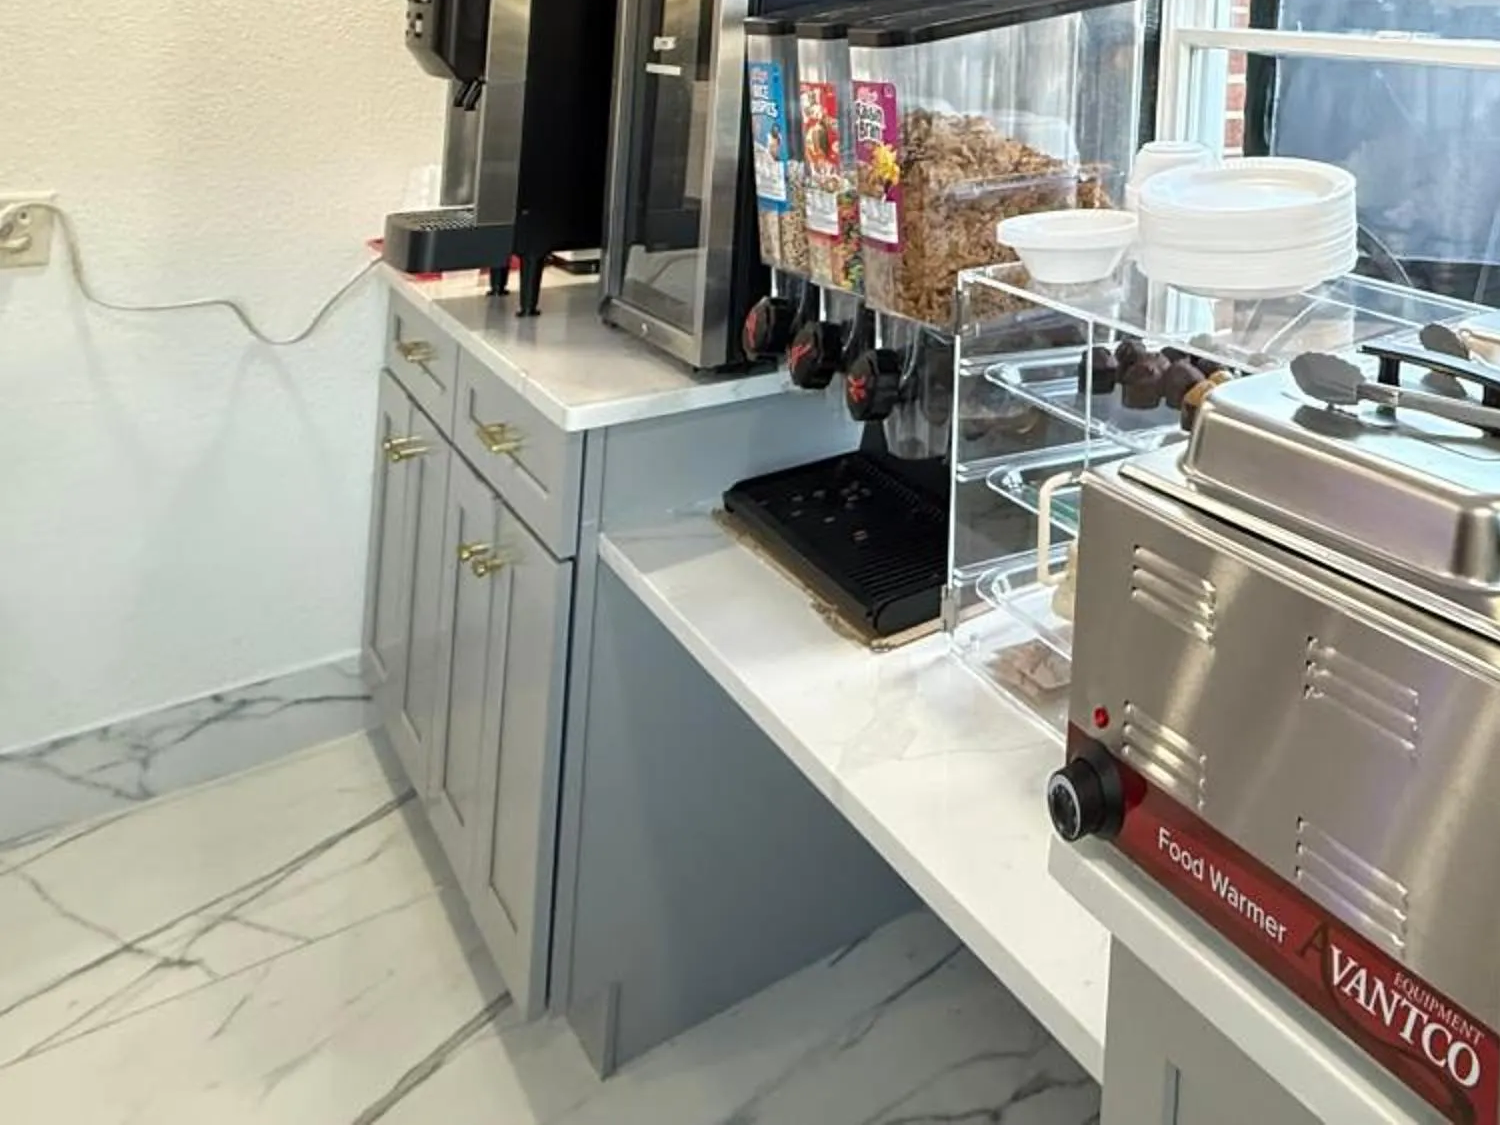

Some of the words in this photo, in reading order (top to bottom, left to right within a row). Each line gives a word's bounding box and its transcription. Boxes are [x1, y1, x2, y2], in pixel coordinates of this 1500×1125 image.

[1158, 827, 1203, 881] Food
[1209, 866, 1287, 944] Warmer
[1299, 922, 1481, 1088] AVANTCO
[1393, 972, 1485, 1046] EQUIPMENT
